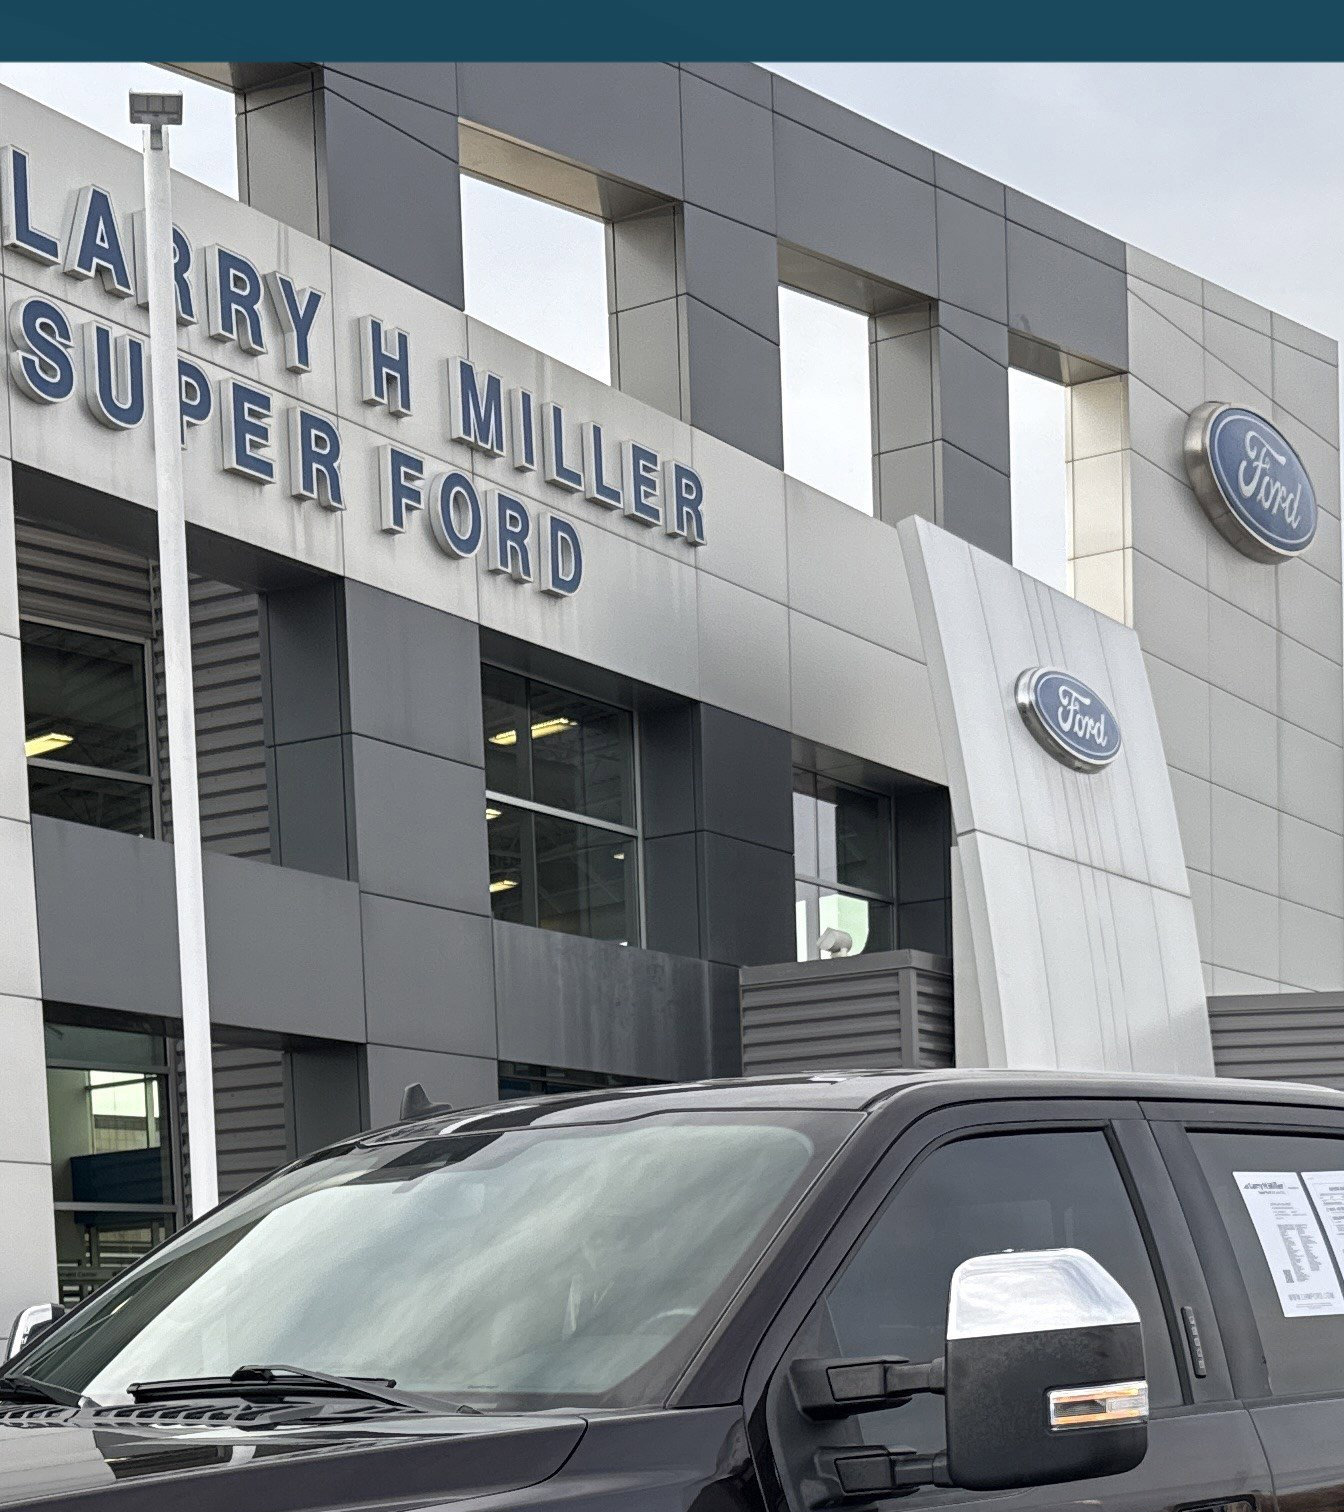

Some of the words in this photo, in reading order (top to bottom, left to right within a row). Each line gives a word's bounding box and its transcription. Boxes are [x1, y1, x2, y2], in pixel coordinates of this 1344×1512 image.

[9, 295, 344, 512] SUPER
[379, 443, 583, 598] FORD
[360, 314, 413, 417] H
[449, 356, 708, 546] MILLER
[1237, 429, 1304, 530] Ford
[1056, 684, 1108, 748] Ford
